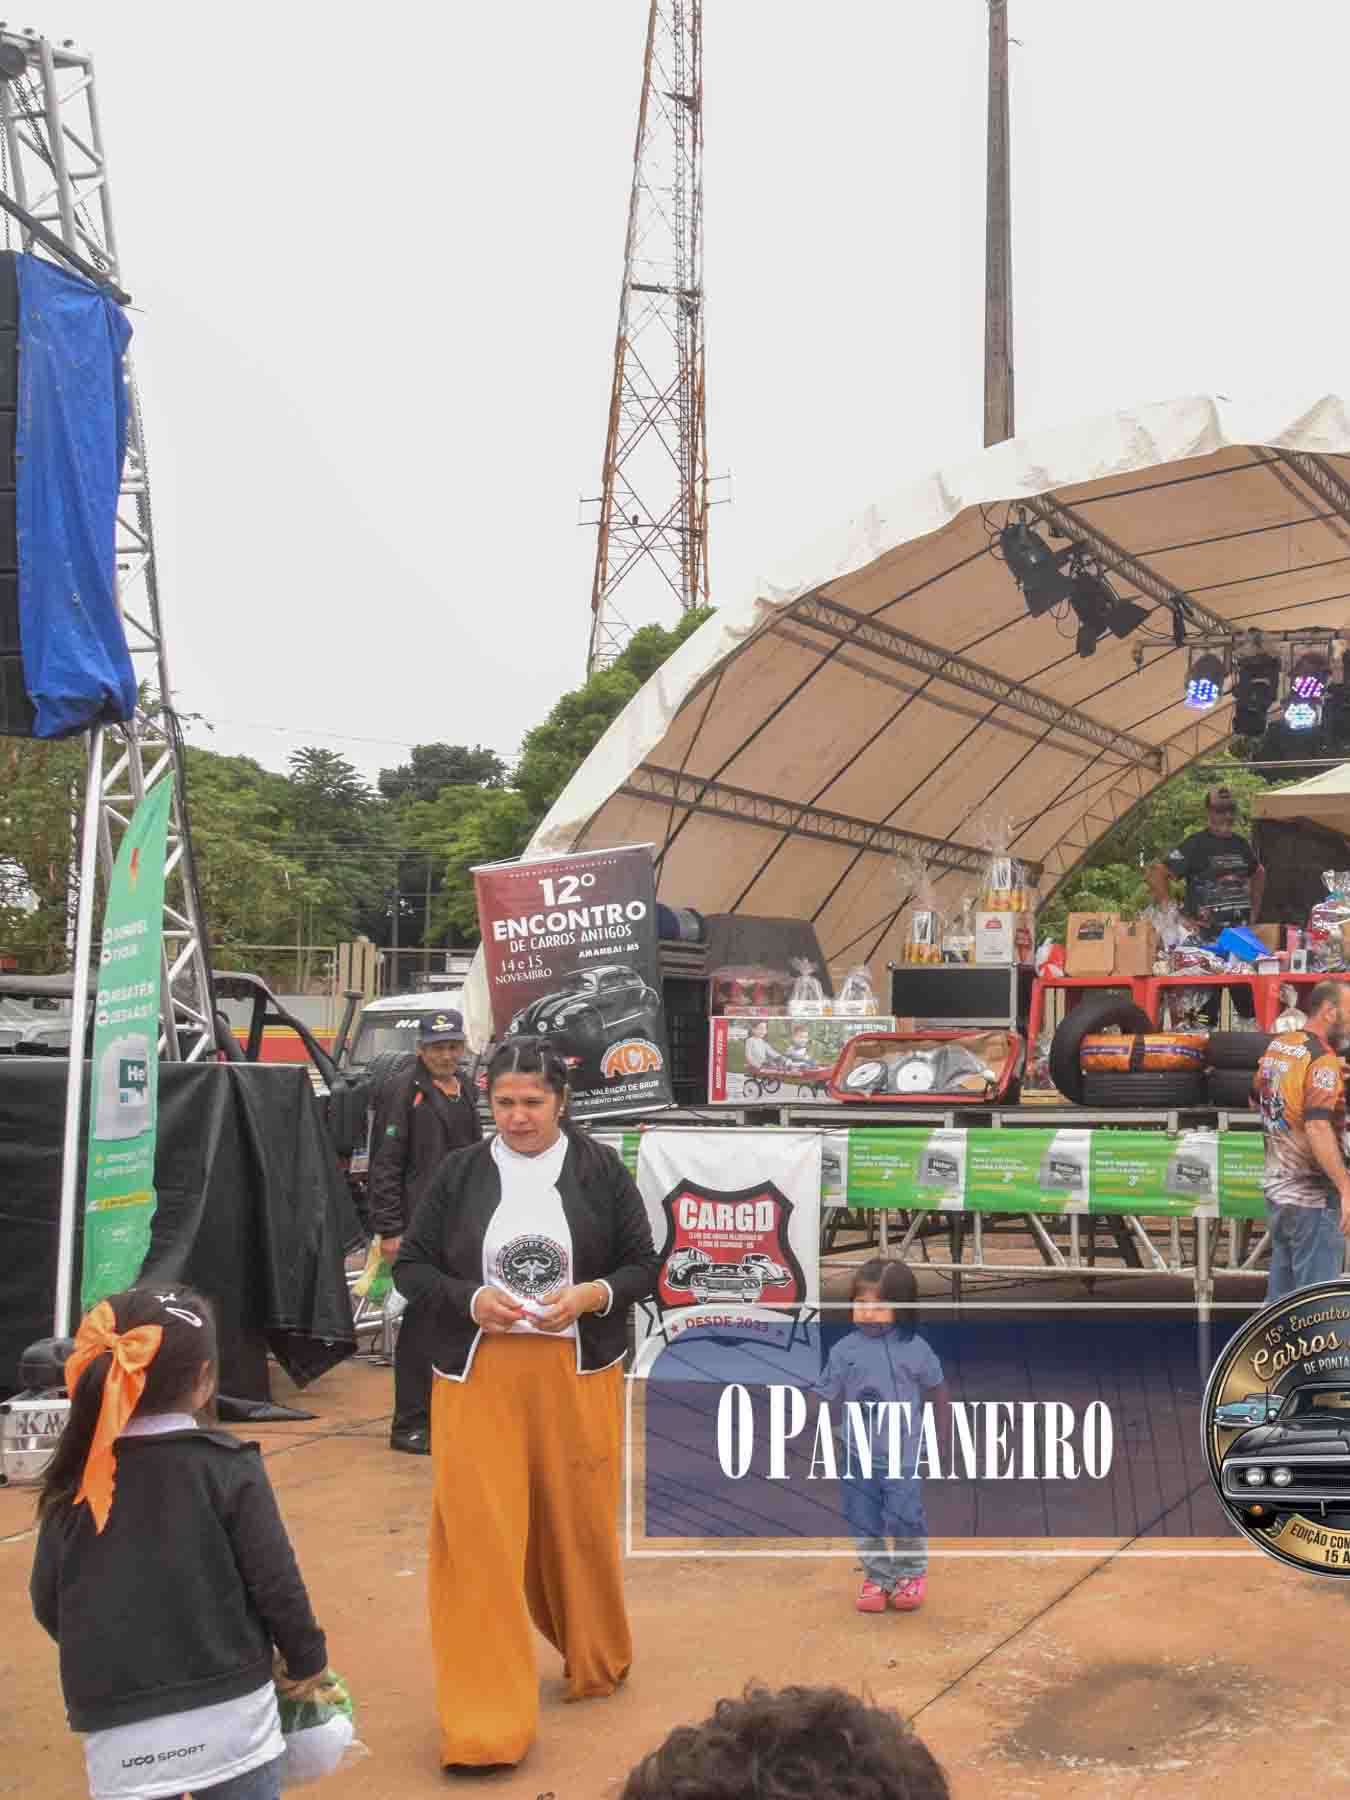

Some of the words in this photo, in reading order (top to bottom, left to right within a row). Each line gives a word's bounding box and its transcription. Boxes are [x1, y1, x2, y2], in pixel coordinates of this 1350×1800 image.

[492, 900, 647, 941] ENCONTRO
[510, 938, 528, 953] DE
[530, 931, 577, 950] CARROS
[580, 925, 632, 944] ANTIGOS
[501, 959, 515, 972] 14
[518, 959, 527, 967] e
[528, 954, 543, 968] 15
[495, 967, 553, 985] NOVEMBRO
[628, 1083, 639, 1091] DE
[685, 1315, 733, 1329] DESDE
[158, 1743, 206, 1761] SPORT
